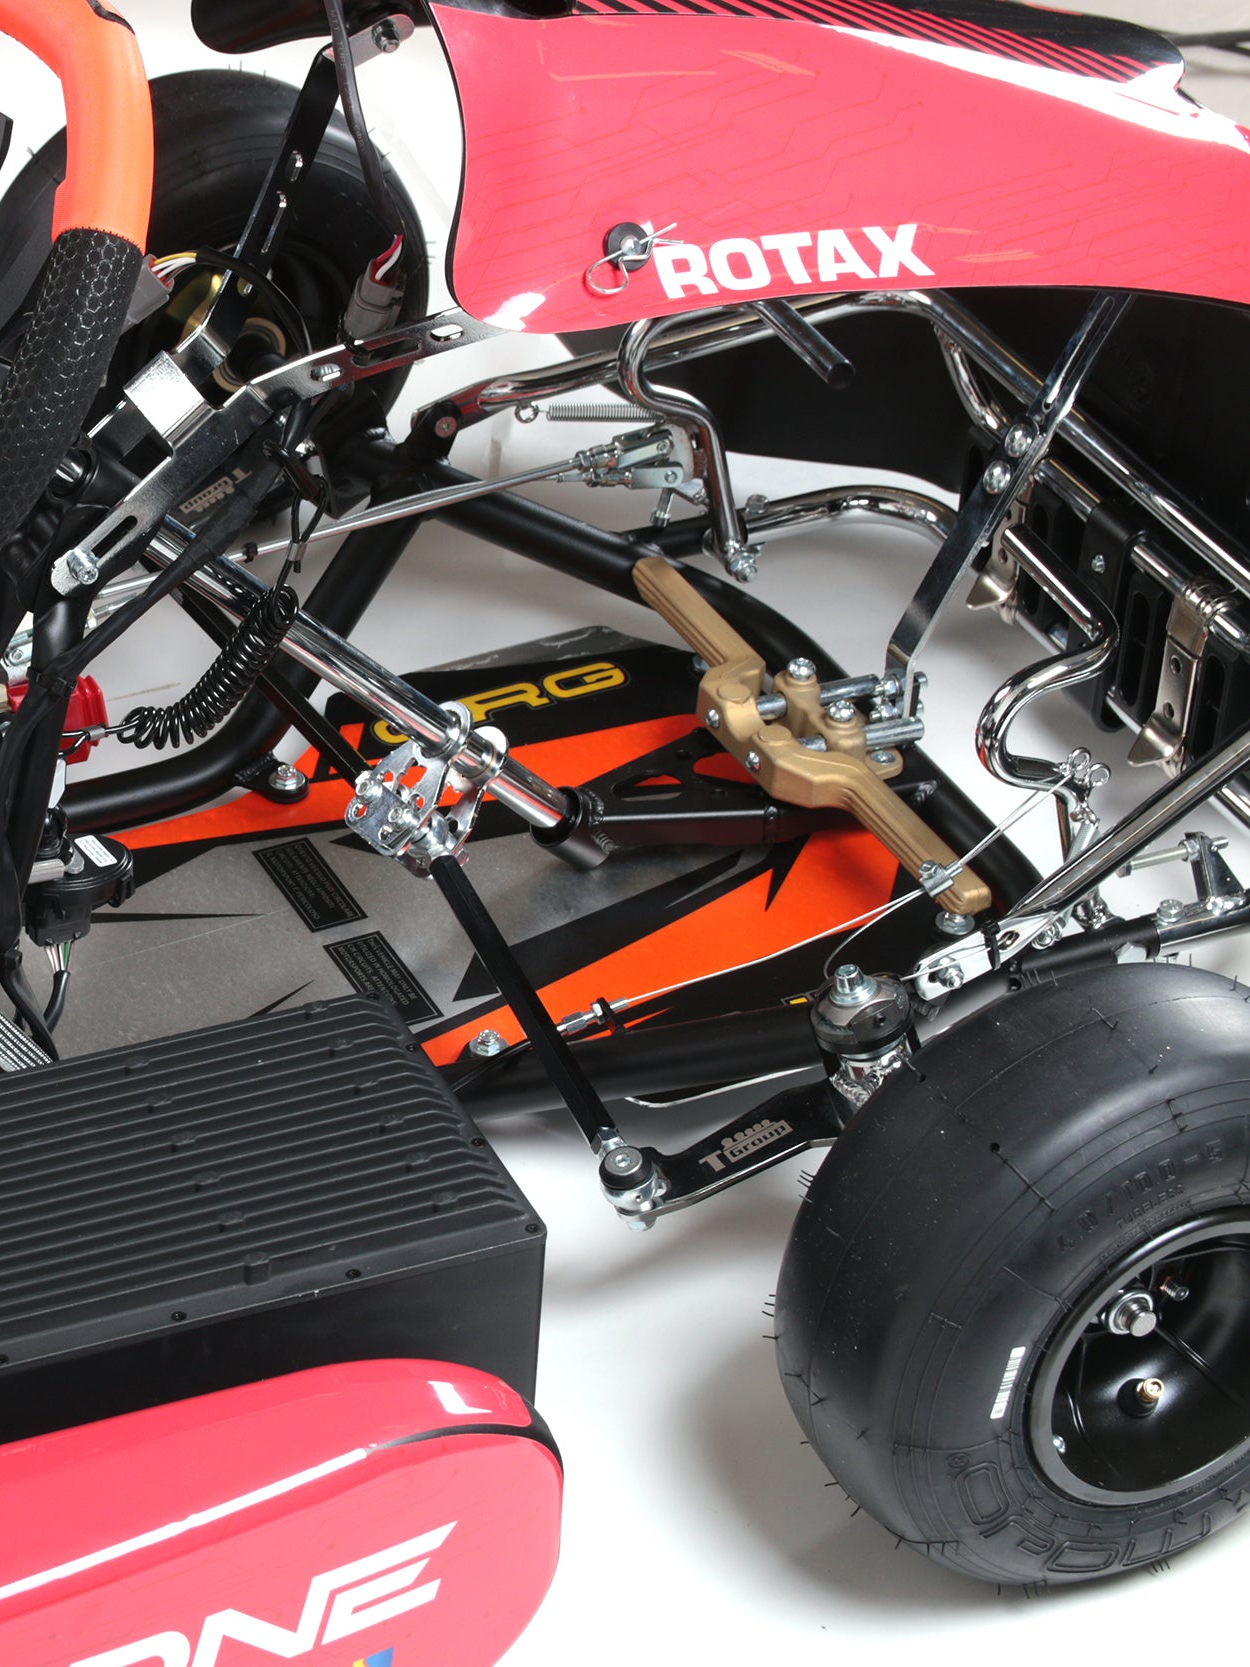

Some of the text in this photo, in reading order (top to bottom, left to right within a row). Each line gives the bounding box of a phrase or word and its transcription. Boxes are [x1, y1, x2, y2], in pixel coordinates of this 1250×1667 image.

[652, 224, 936, 299] ROTAX
[336, 946, 368, 982] MOTORSPORTS
[366, 938, 418, 1000] THIS VEHICLE MAY ONLY BE
[376, 967, 410, 1005] HOMOLOGATED
[728, 1124, 787, 1159] Group
